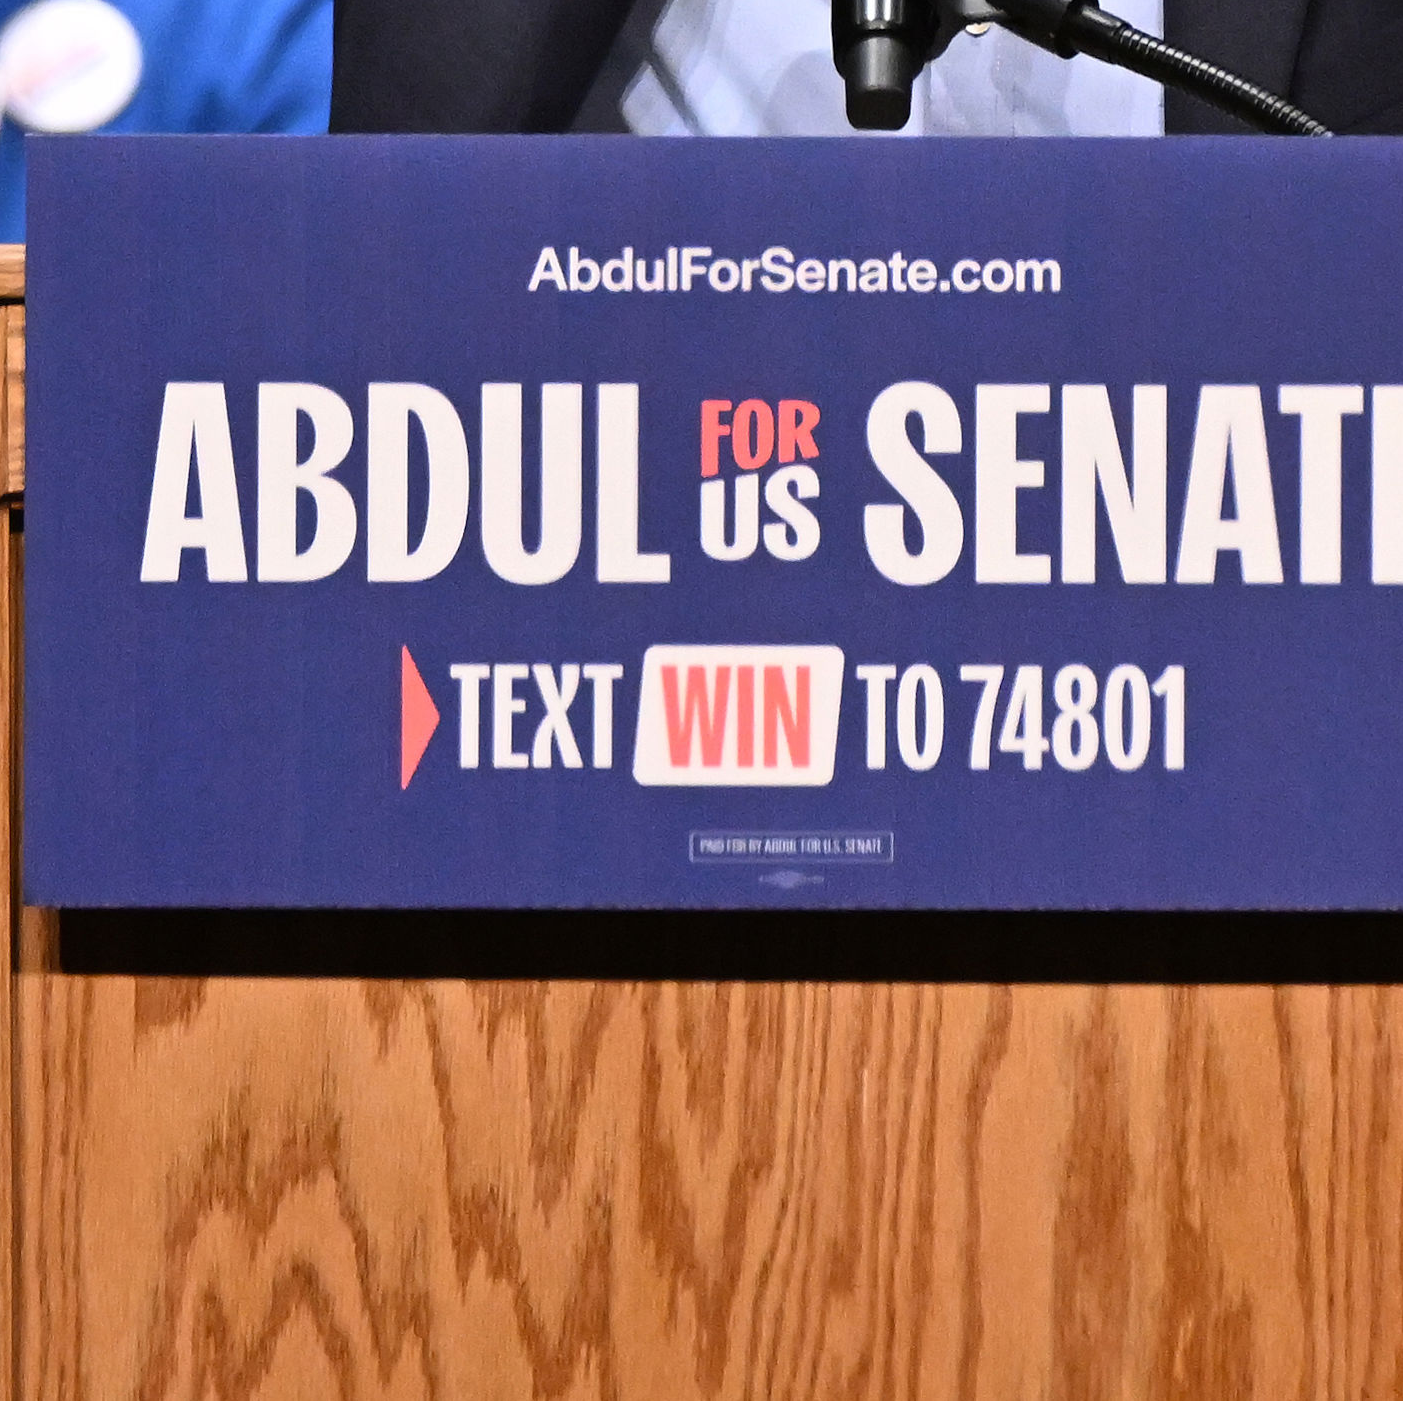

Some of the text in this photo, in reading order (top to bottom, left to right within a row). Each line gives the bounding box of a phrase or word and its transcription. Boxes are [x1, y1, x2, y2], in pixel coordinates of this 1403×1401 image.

[527, 246, 1062, 293] AbdulForSenate.com
[139, 381, 671, 585] ABDUL
[699, 398, 821, 479] FOR
[699, 464, 821, 562] US
[449, 663, 1185, 772] TEXT WIN TO 74801
